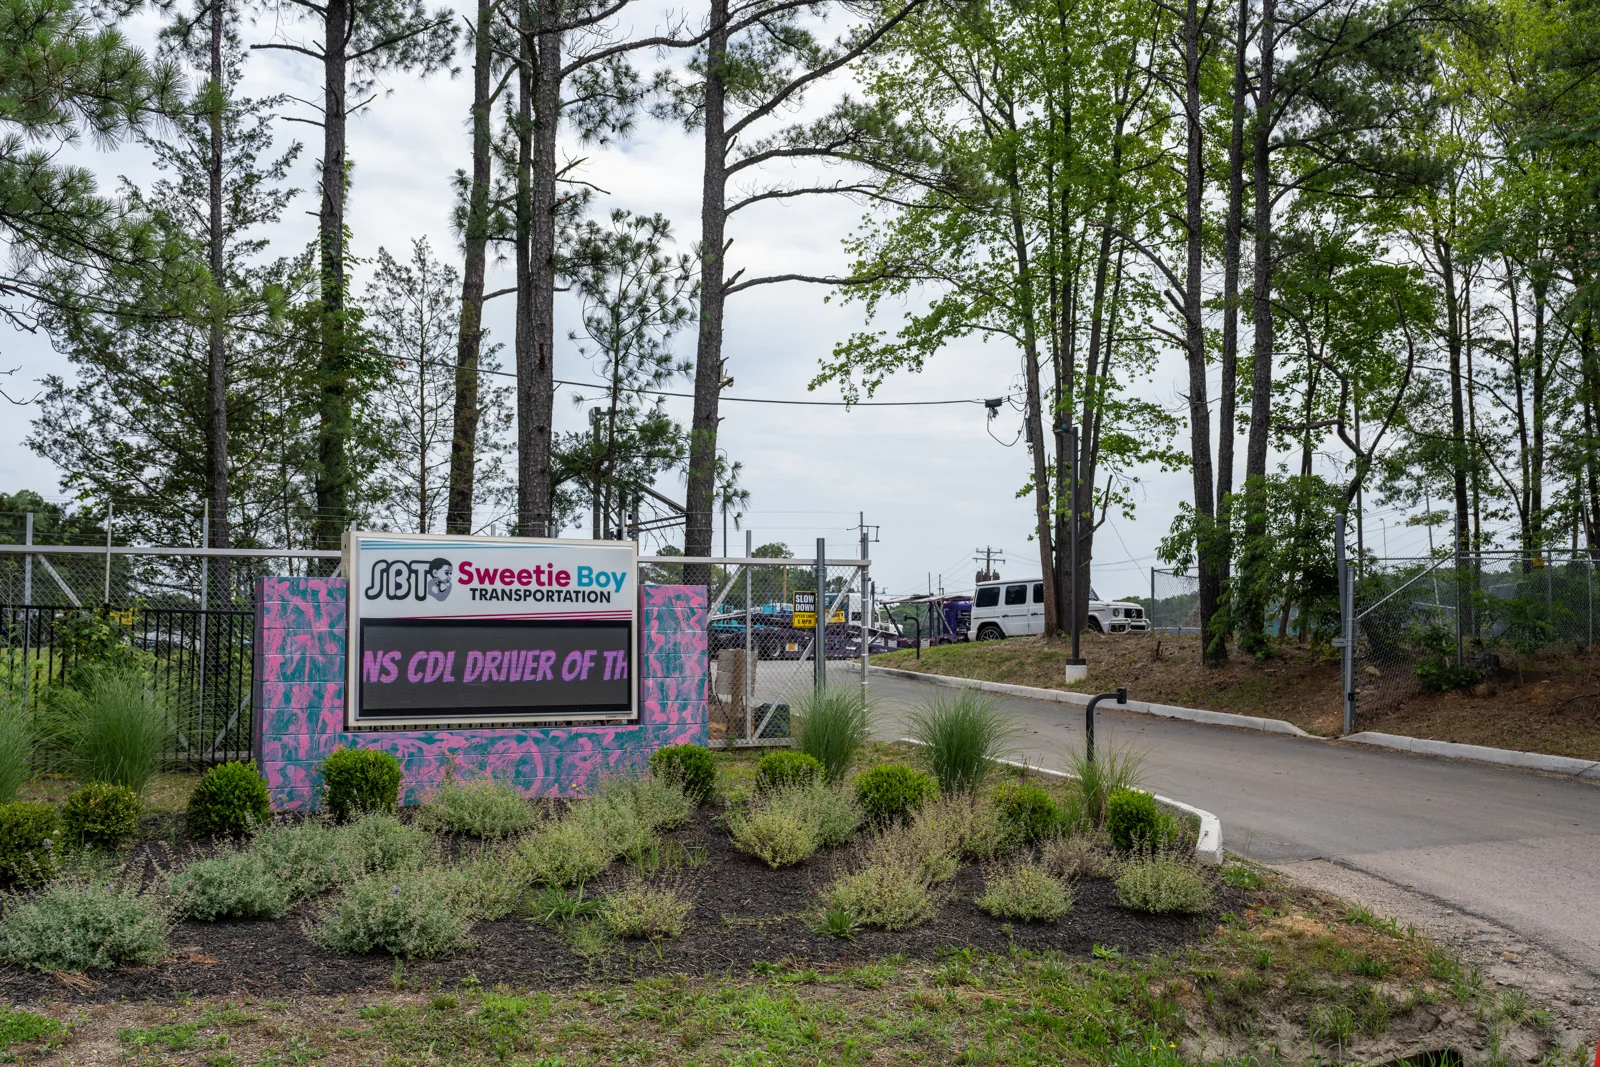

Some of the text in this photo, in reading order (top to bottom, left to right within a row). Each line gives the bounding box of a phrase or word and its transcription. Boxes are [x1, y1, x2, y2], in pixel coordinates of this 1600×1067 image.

[365, 559, 431, 601] SBT
[457, 560, 627, 593] Sweetie Boy
[470, 587, 611, 603] TRANSPORTATION
[796, 594, 814, 603] SLOW
[796, 604, 814, 612] DOWN
[407, 650, 456, 683] CDL
[463, 649, 556, 683] DRIVER
[561, 649, 598, 682] OF
